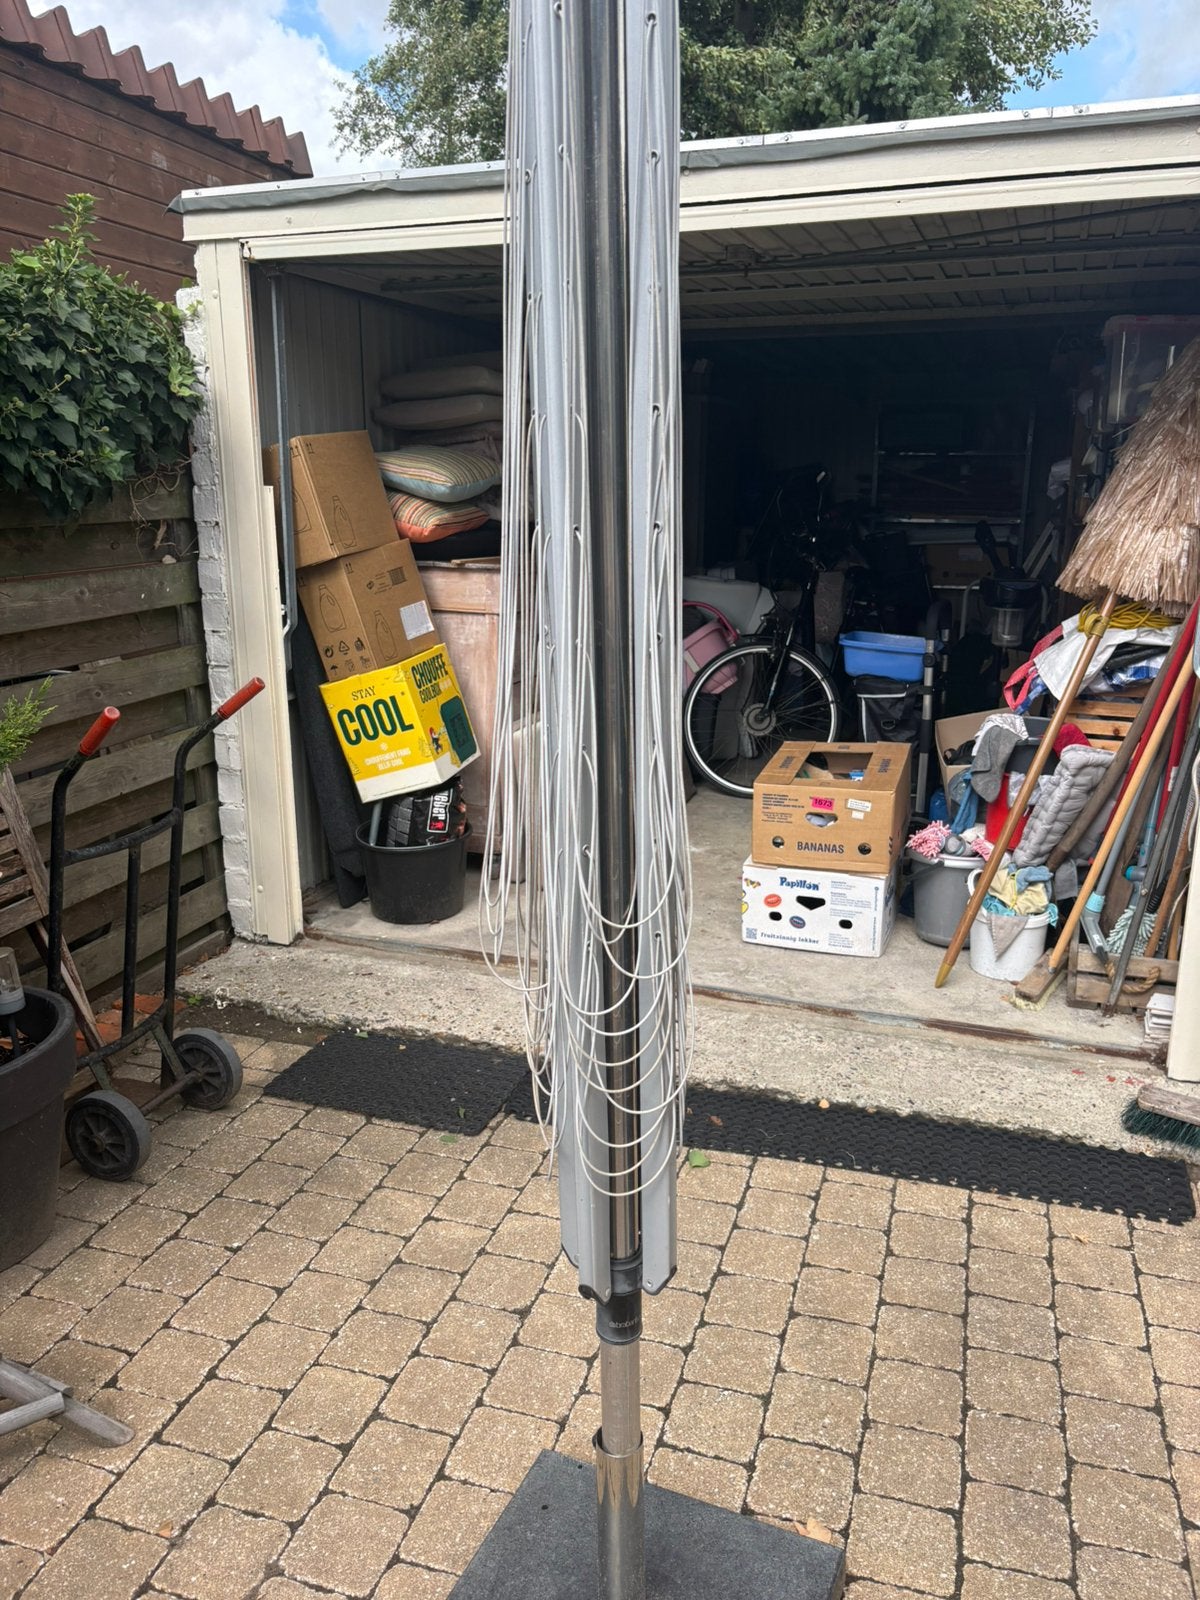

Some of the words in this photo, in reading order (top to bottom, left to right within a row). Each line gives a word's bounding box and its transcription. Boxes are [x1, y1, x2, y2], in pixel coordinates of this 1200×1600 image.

[411, 653, 448, 689] CHOUFFE
[351, 685, 376, 701] STAY
[337, 695, 415, 746] COOL
[814, 798, 833, 808] 1673
[797, 841, 844, 854] BANANAS
[779, 876, 819, 891] Papillon
